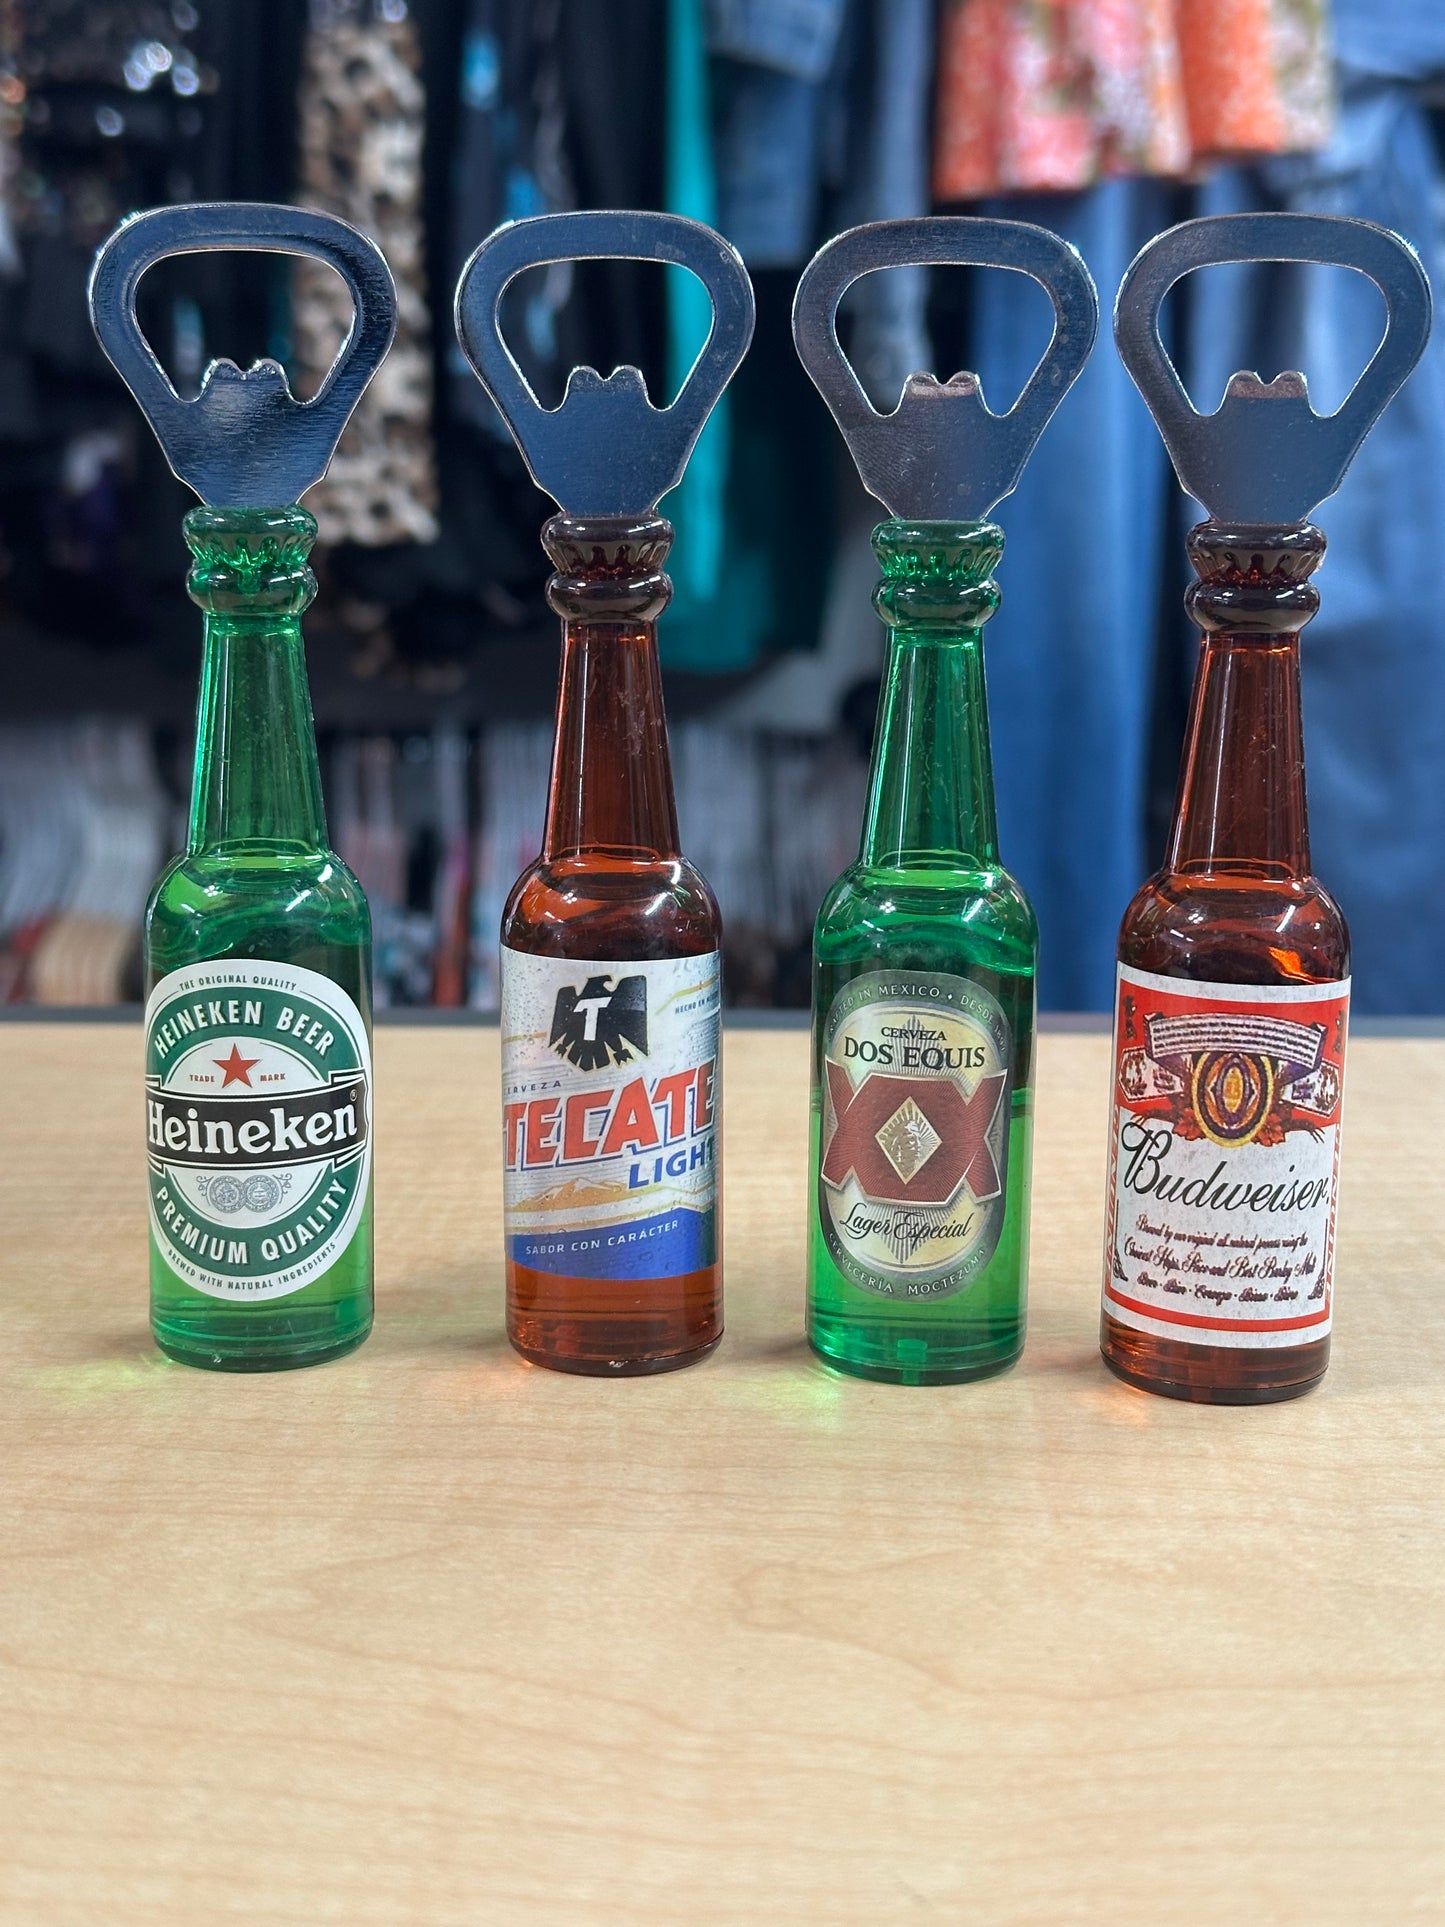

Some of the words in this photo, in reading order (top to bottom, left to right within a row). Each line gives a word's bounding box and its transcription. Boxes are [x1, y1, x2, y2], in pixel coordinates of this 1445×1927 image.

[179, 981, 195, 991] THE
[199, 975, 248, 986] ORIGINAL
[253, 976, 297, 991] QUALITY
[858, 988, 873, 1001] IN
[878, 984, 940, 998] MEXICO
[154, 1000, 263, 1060] HEINEKEN
[275, 1006, 336, 1057] BEER
[573, 996, 613, 1041] T
[881, 1026, 947, 1041] CERVEZA
[843, 1036, 894, 1065] DOS
[901, 1046, 986, 1071] EQUIS
[189, 1074, 215, 1084] TRADE
[259, 1073, 286, 1084] MARK
[148, 1099, 358, 1154] Heineken
[503, 1062, 715, 1168] TECATE
[629, 1135, 715, 1189] LIGHT
[156, 1186, 249, 1265] PREMIUM
[261, 1178, 348, 1263] QUALITY
[526, 1243, 565, 1255] SABOR
[571, 1239, 601, 1252] CON
[607, 1219, 679, 1247] CARÁCTER
[839, 1202, 893, 1241] Lager
[893, 1210, 975, 1249] Especial
[168, 1249, 197, 1277] BREWED
[199, 1274, 224, 1288] WITH
[228, 1279, 275, 1291] NATURAL
[278, 1242, 337, 1285] INGREDIENTS
[829, 1232, 895, 1294] CERVECERÍA
[907, 1248, 986, 1296] MOCTEZUMA
